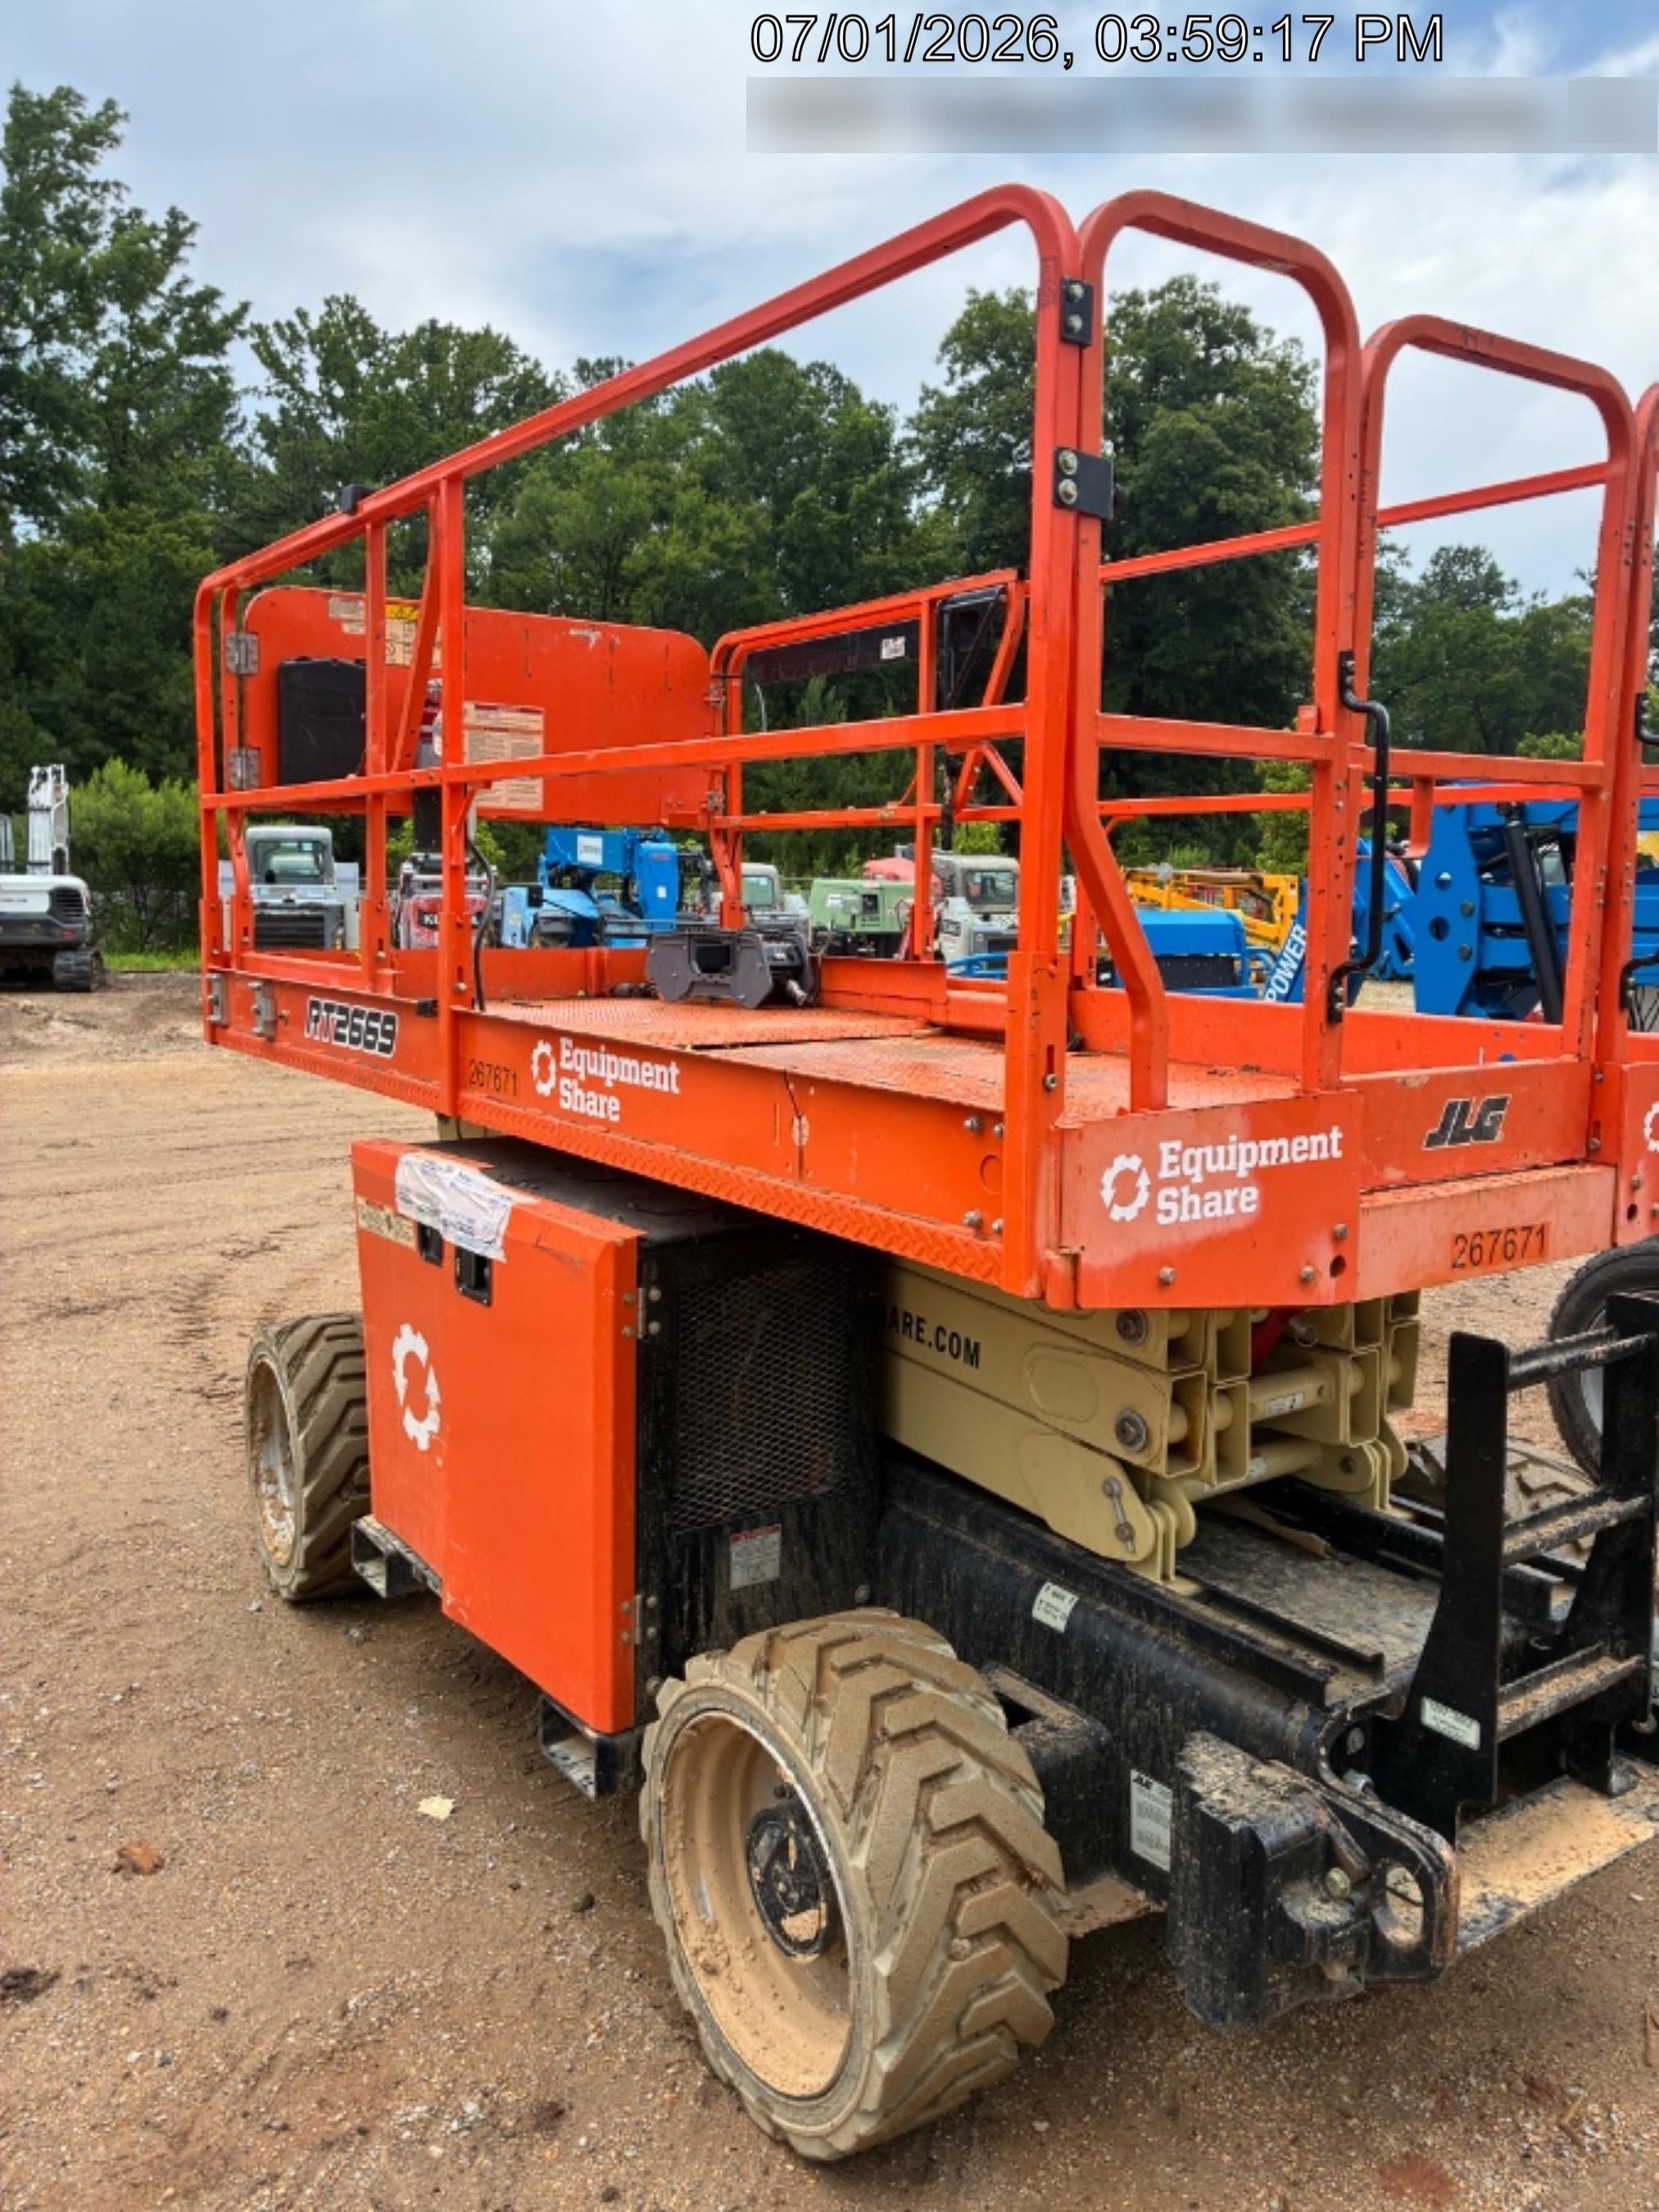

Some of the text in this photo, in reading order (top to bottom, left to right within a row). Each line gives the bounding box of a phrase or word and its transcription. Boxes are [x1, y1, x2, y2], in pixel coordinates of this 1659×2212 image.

[1265, 923, 1307, 1001] POWER
[304, 996, 398, 1058] RT2669
[469, 1058, 517, 1096] 267671
[560, 1036, 680, 1095] Equipment
[560, 1077, 620, 1122] Share
[1422, 1094, 1512, 1151] JLG
[1157, 1125, 1344, 1183] Equipment
[1156, 1185, 1259, 1226] Share
[1451, 1223, 1546, 1269] 267671
